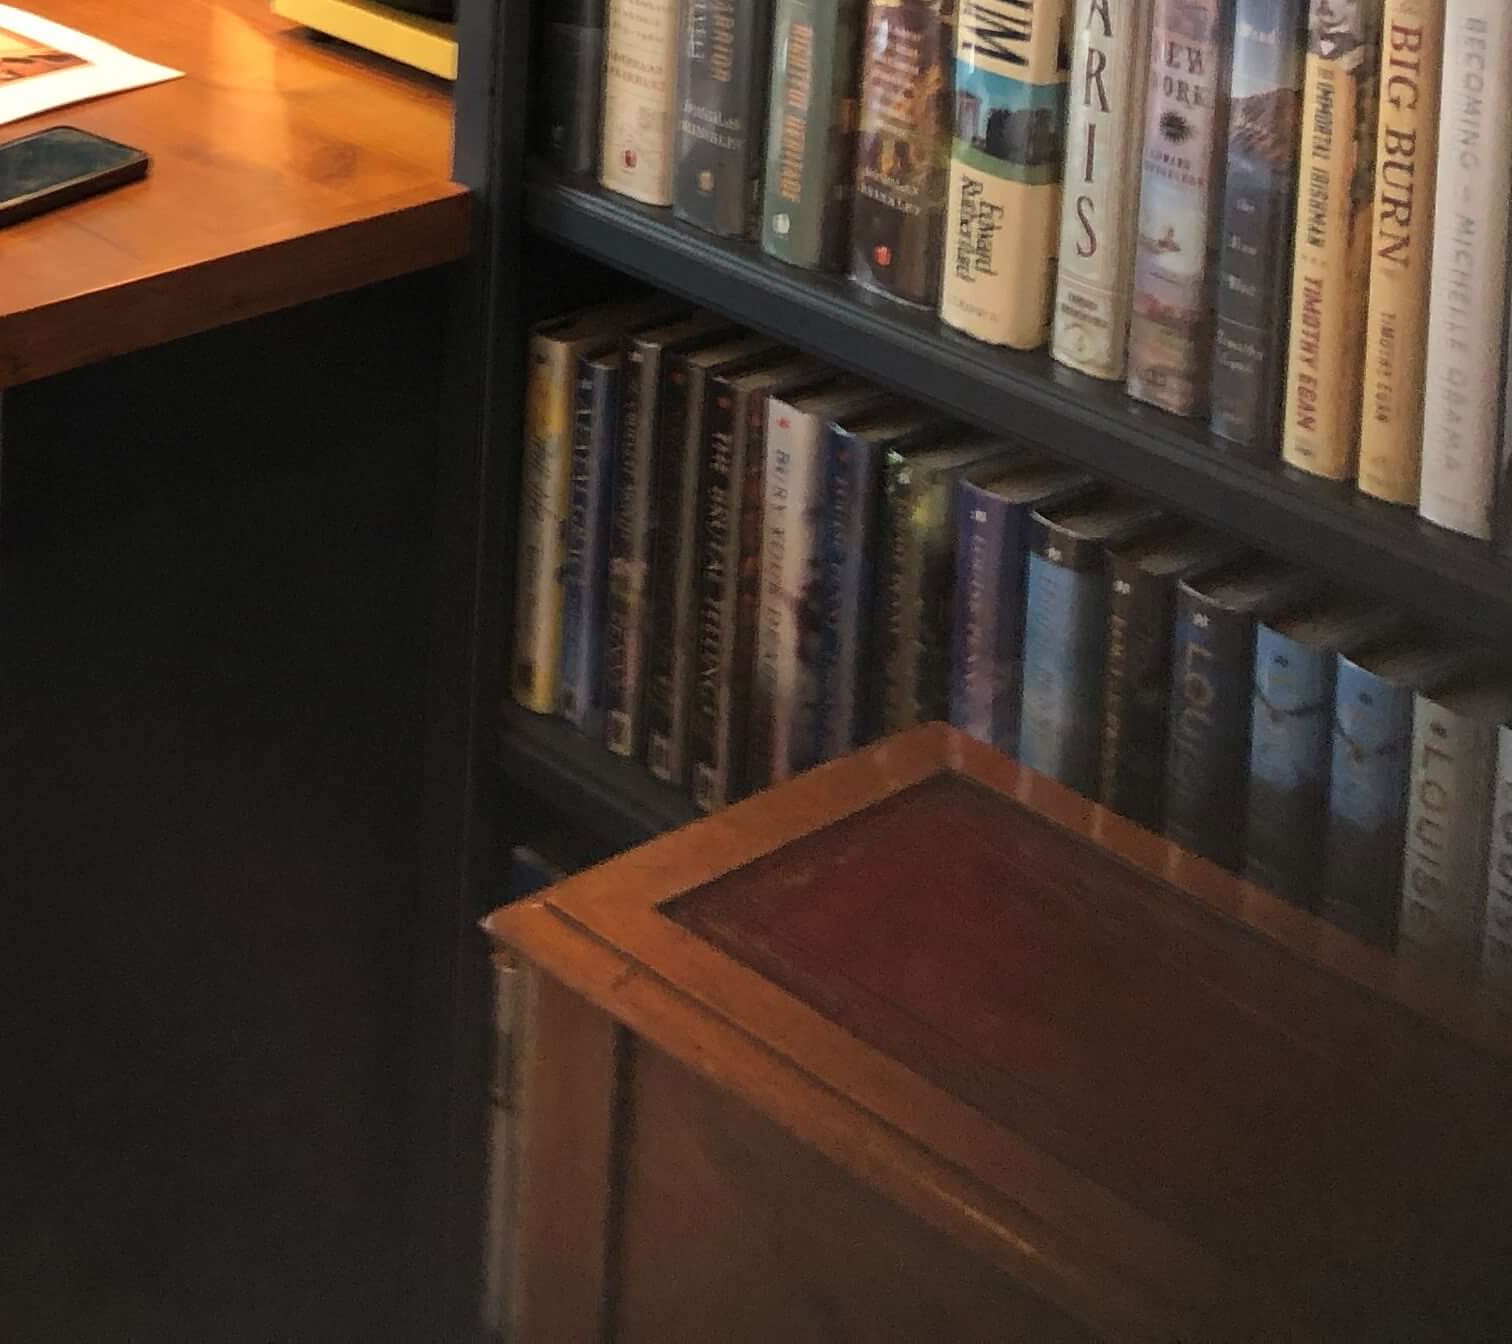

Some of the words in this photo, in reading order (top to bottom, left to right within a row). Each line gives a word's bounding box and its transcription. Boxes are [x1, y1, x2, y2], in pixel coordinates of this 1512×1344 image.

[1385, 23, 1424, 114] BIG
[1456, 16, 1486, 171] BECOMING
[1308, 81, 1336, 160] IMMORTAL
[1304, 167, 1331, 249] IRISHMAN
[1375, 125, 1417, 268] BURN
[1298, 274, 1324, 370] TIMOTHY
[1444, 214, 1476, 351] MICHELLE
[1294, 374, 1321, 430] EGAN
[1440, 361, 1468, 473] OBAMA
